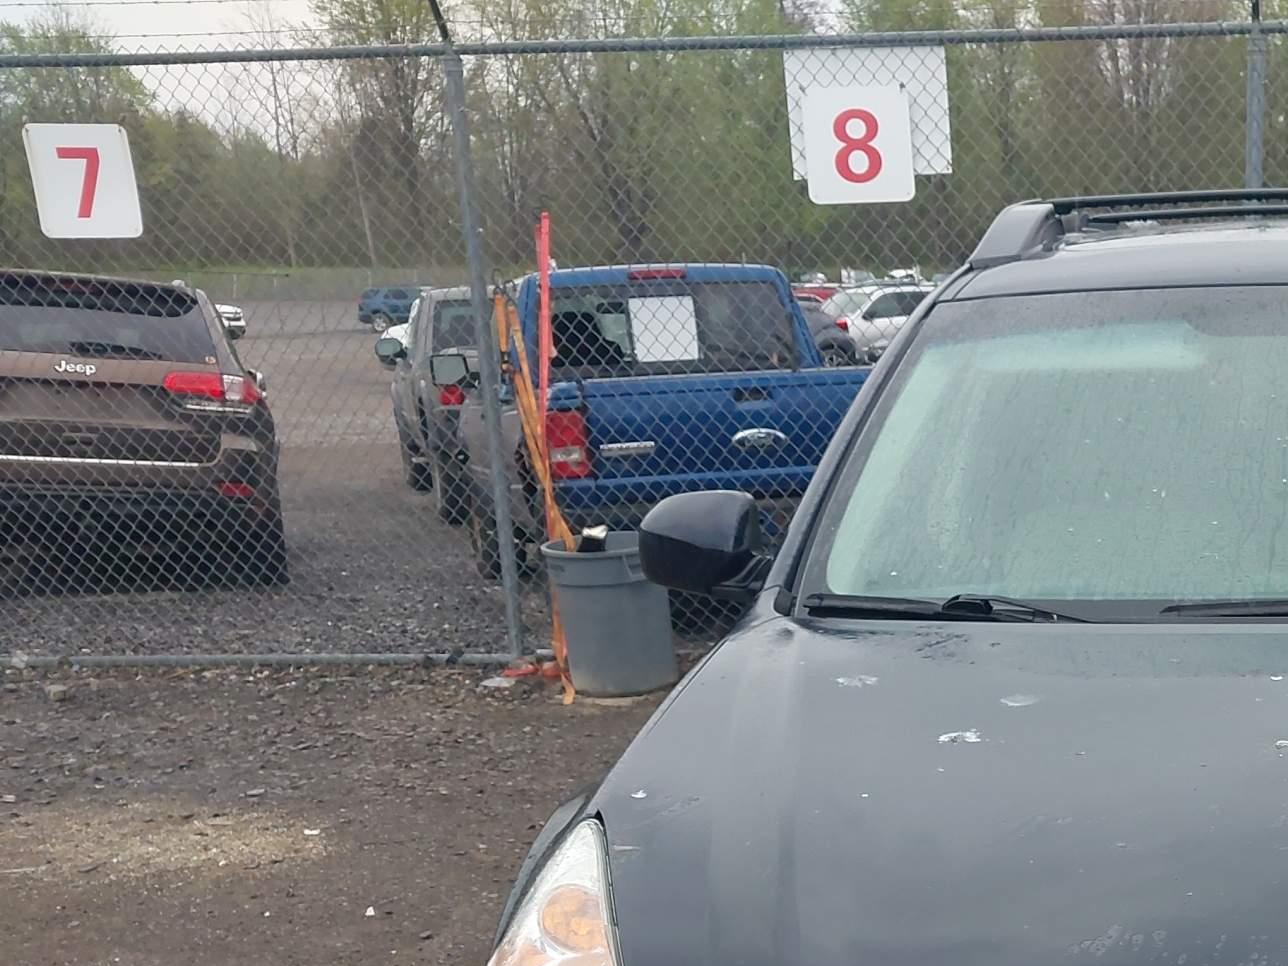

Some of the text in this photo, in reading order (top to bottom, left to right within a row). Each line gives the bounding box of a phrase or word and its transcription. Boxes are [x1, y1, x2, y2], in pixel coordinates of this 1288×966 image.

[833, 108, 883, 183] 8
[57, 147, 100, 218] 7
[54, 360, 97, 376] Jeep
